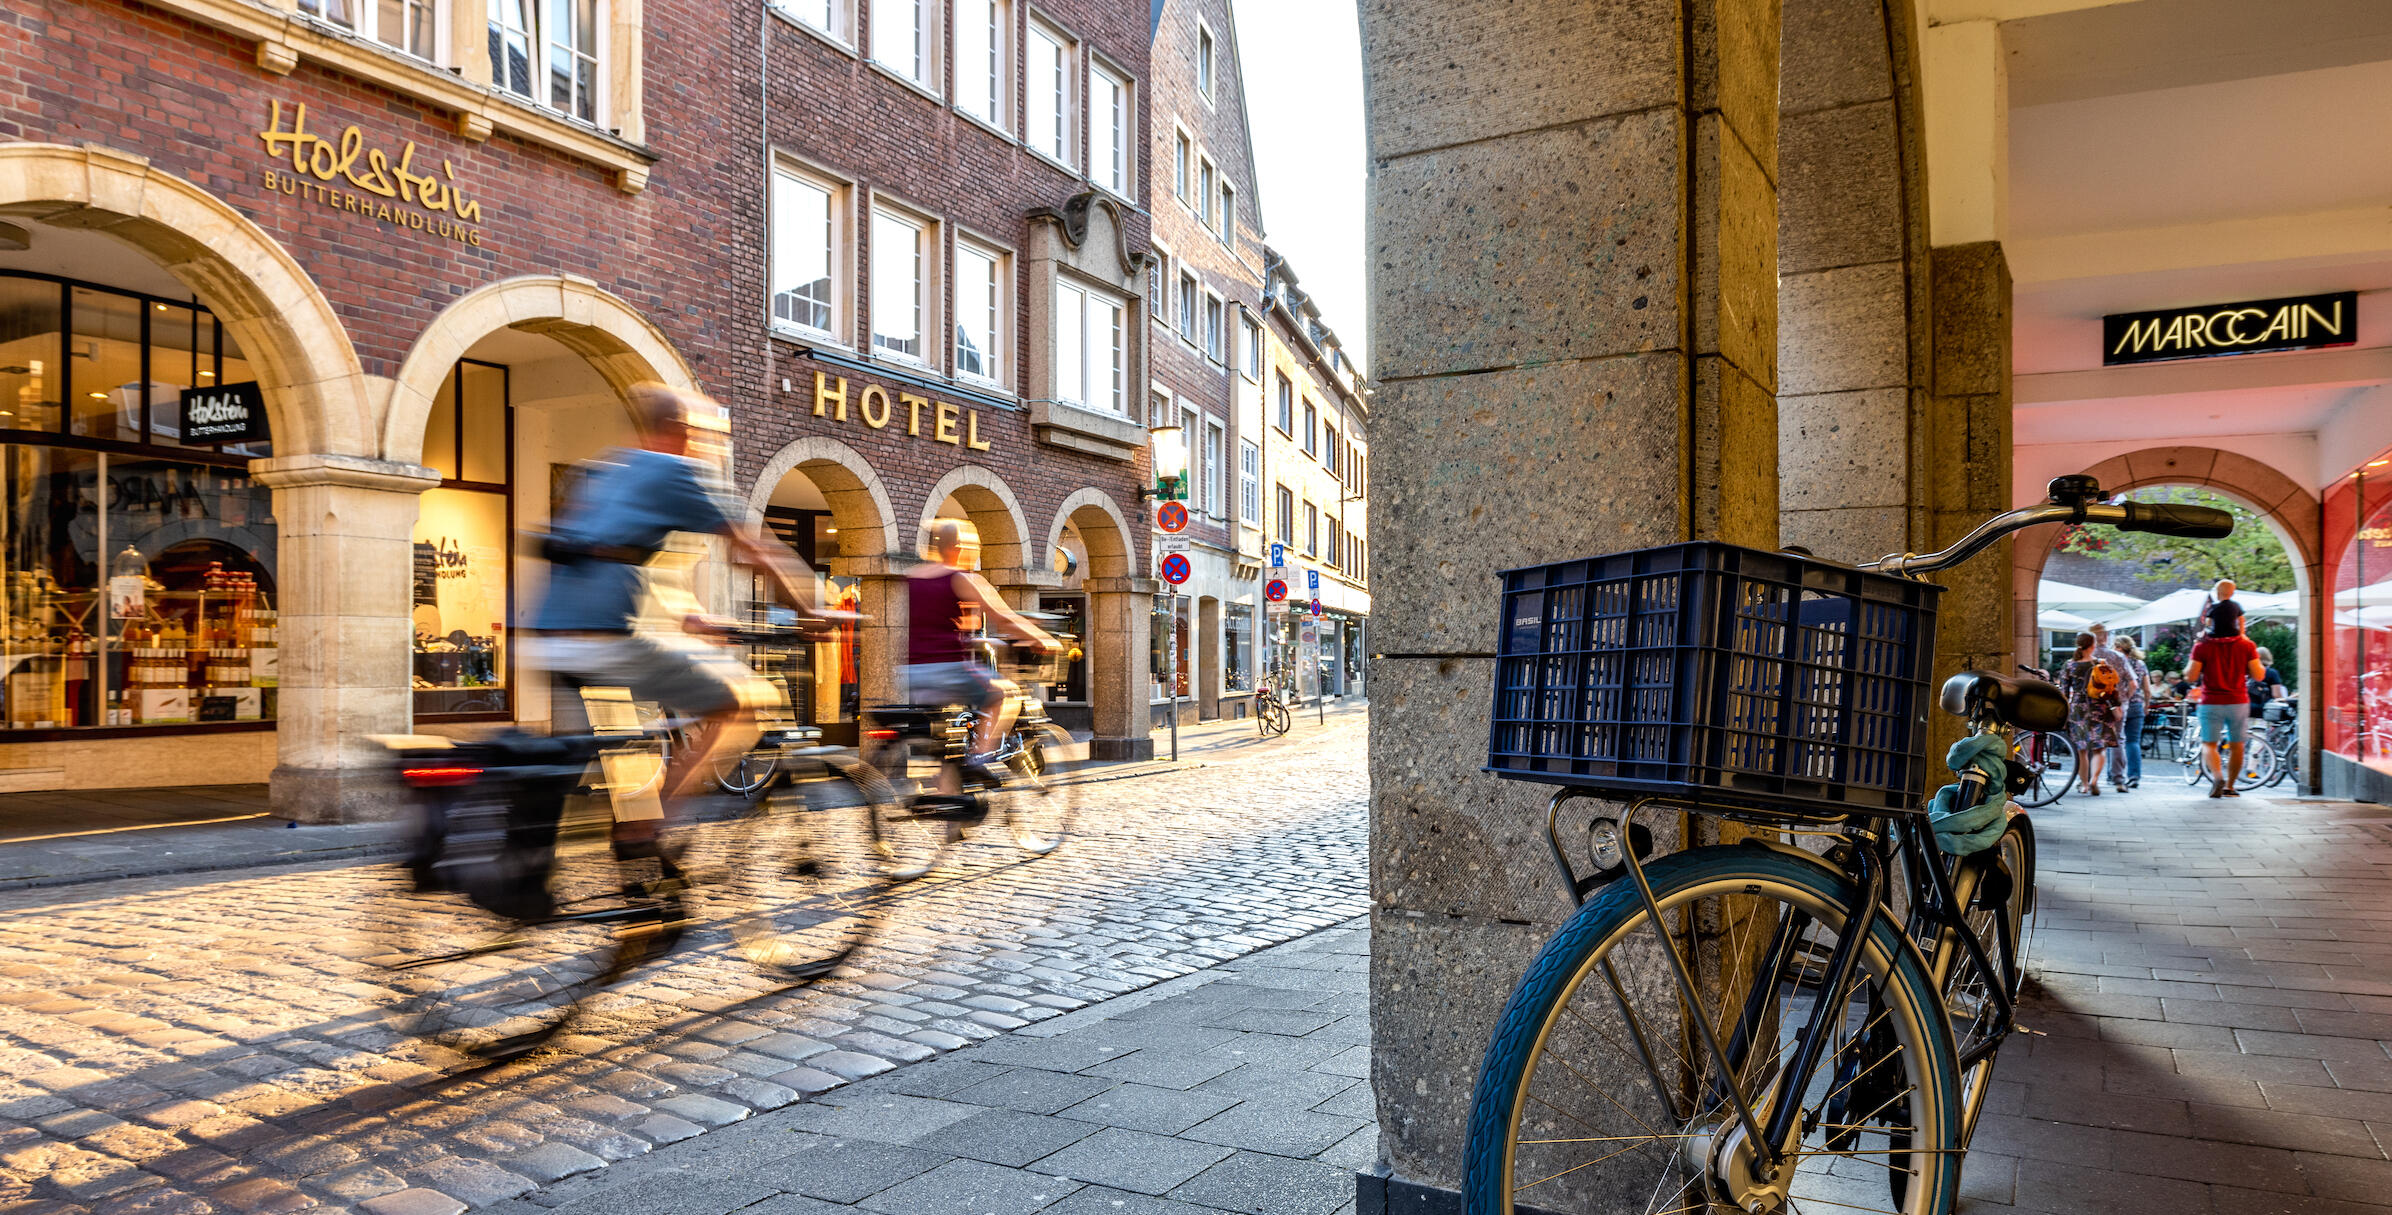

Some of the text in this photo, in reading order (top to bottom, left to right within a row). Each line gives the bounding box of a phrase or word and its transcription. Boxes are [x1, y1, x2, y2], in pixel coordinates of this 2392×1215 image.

[260, 99, 480, 223] Holstein
[265, 171, 480, 246] BUTTERHANDLUNG
[188, 392, 249, 424] Holstein
[813, 370, 991, 452] HOTEL
[1273, 546, 1281, 564] P
[1309, 572, 1317, 587] P
[1515, 616, 1542, 626] BASIL
